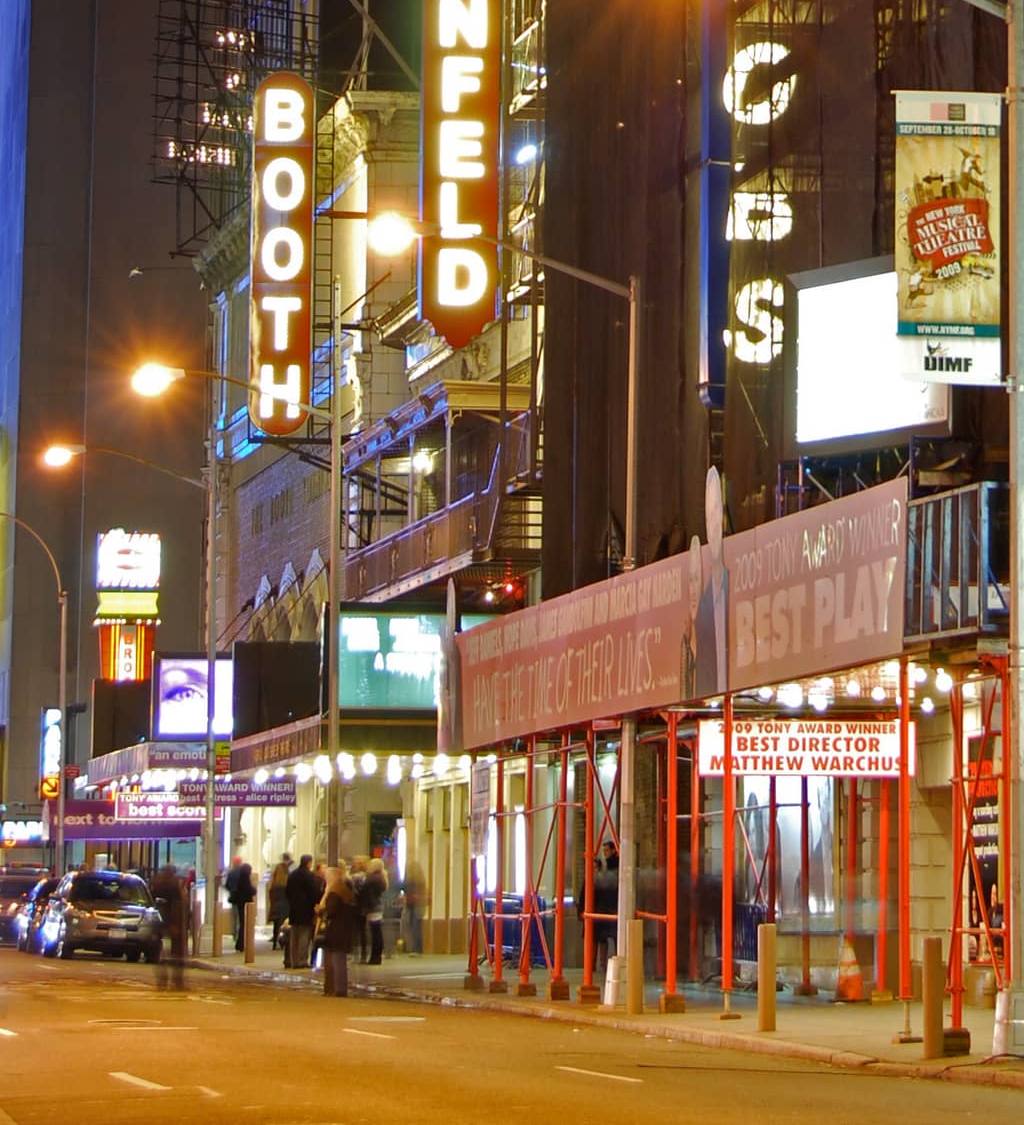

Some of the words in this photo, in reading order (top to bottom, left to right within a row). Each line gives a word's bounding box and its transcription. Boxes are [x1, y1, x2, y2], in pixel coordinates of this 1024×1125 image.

[916, 213, 979, 240] MUSICAL
[913, 225, 987, 255] THEATRE
[260, 89, 305, 418] BOOTH
[935, 261, 962, 280] 2009
[766, 530, 800, 586] TONY
[849, 498, 901, 557] WINNER
[736, 583, 807, 668] BEST
[814, 556, 898, 650] PLAY
[502, 662, 525, 724] THE
[555, 646, 574, 714] OF
[574, 634, 615, 706] THEIR
[718, 723, 752, 735] 209
[757, 723, 792, 735] TONY
[797, 723, 842, 735] AWARD
[845, 723, 897, 735] WINNER
[172, 748, 207, 760] emoti
[736, 736, 780, 753] BEST
[787, 736, 881, 753] DIRECTOR
[119, 794, 145, 803] TONY
[202, 794, 237, 803] atress
[245, 794, 268, 803] alice
[270, 794, 296, 805] ripley
[128, 804, 164, 817] best
